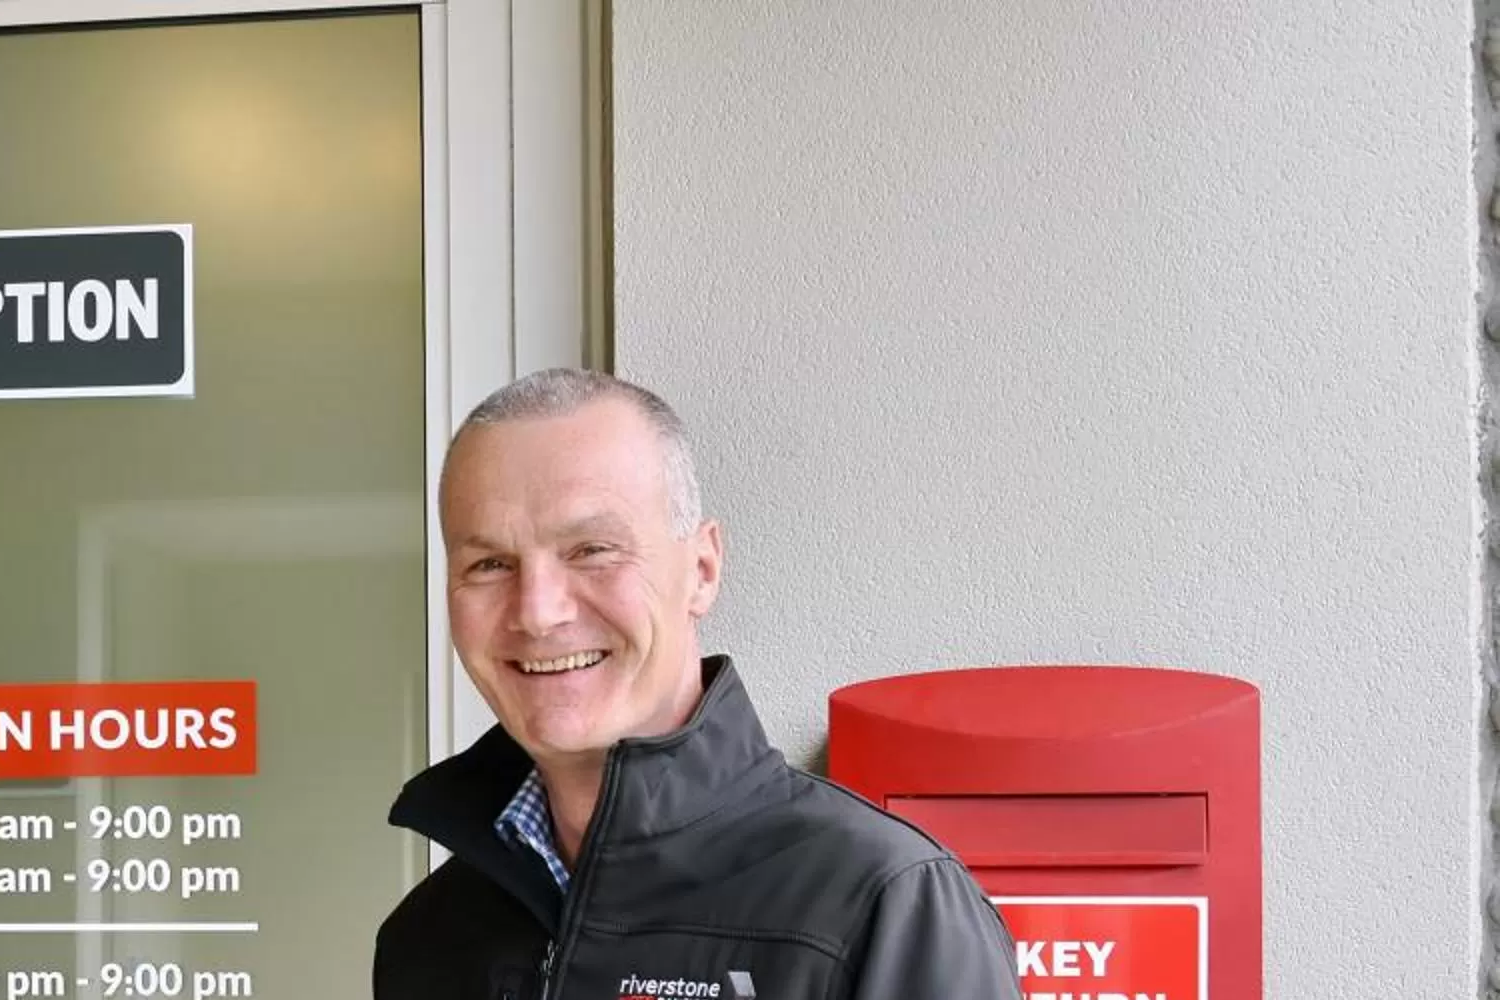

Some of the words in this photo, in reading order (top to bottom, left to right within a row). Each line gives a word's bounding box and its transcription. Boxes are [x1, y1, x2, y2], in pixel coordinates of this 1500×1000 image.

[50, 707, 238, 751] HOURS
[88, 805, 172, 840] 9:00
[182, 813, 242, 845] pm
[86, 858, 171, 893] 9:00
[181, 866, 240, 899] pm
[1015, 940, 1117, 978] KEY
[100, 963, 183, 997] 9:00
[619, 974, 721, 997] riverstone
